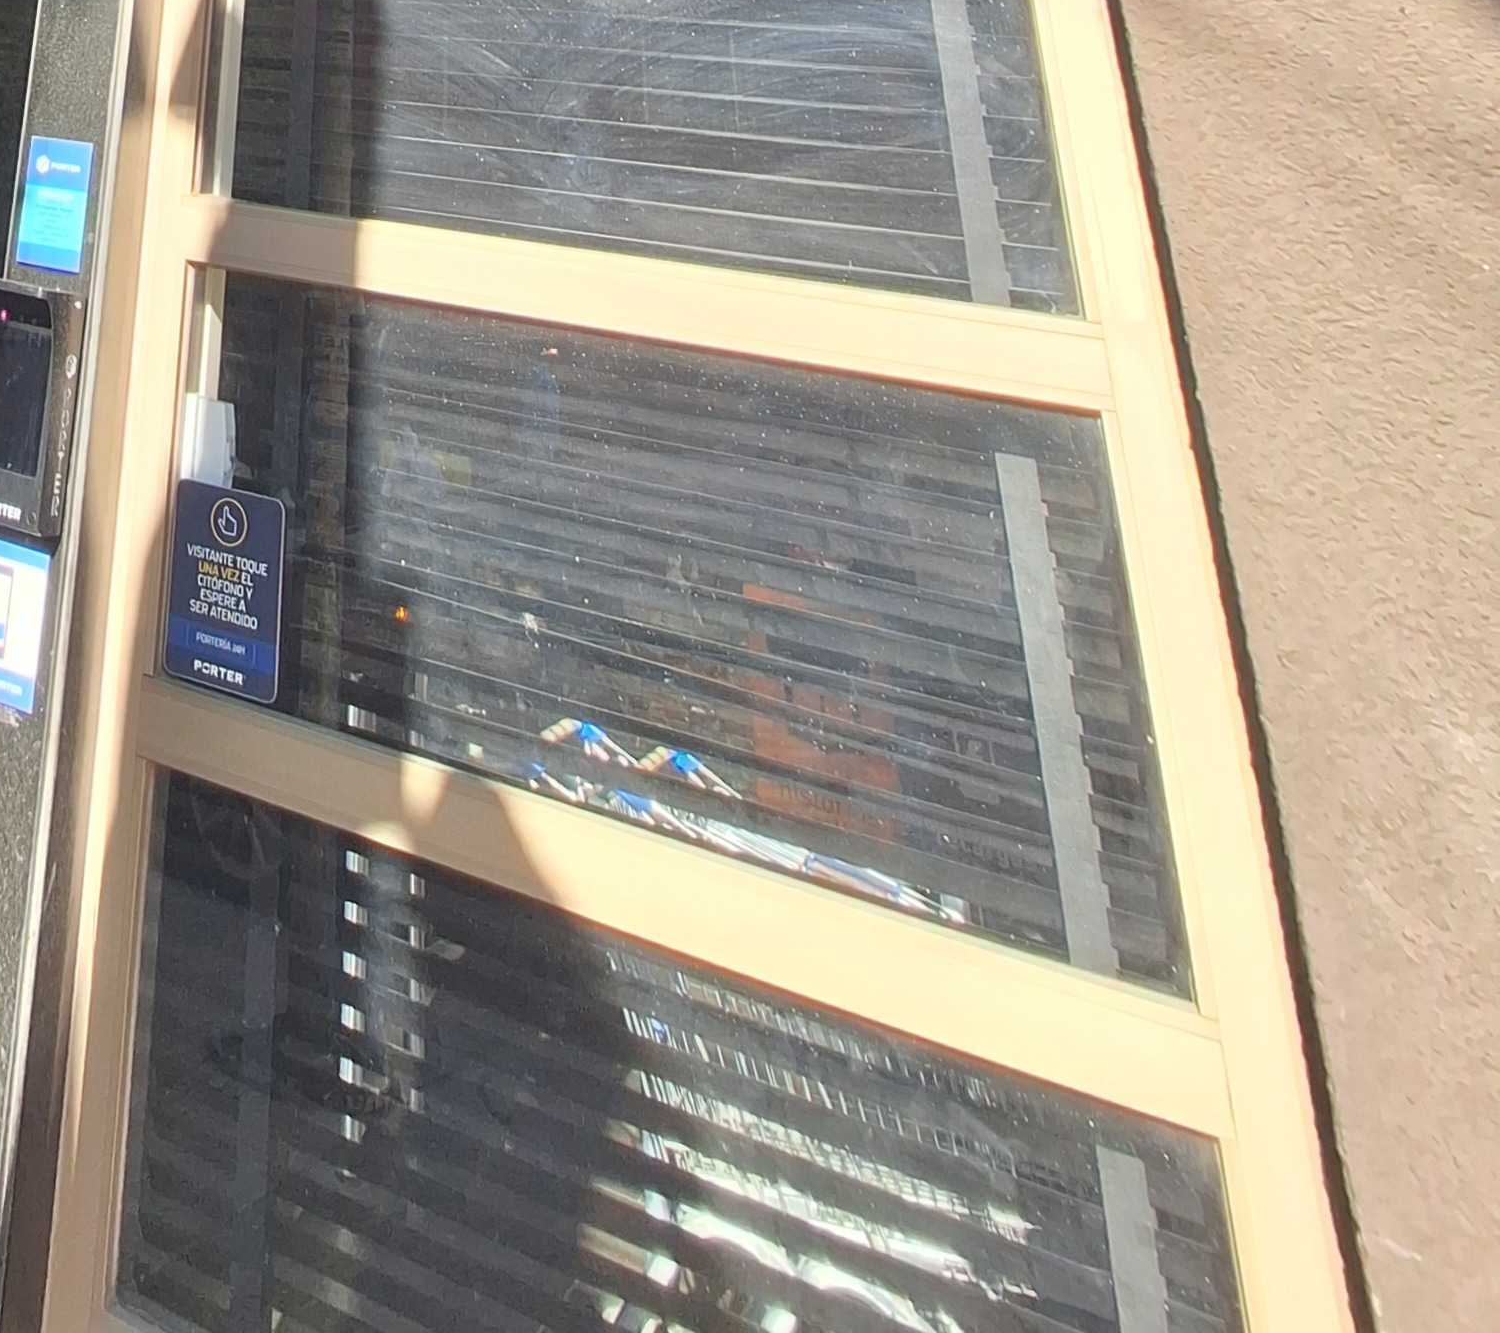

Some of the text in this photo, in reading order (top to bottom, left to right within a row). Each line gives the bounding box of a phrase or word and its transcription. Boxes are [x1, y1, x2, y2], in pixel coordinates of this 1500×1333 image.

[187, 543, 268, 577] VISITANTE TOQUE
[199, 560, 254, 586] UNA VEZ EL
[200, 588, 247, 613] ESPERE A
[246, 586, 253, 601] Y
[189, 599, 258, 630] SER ATENDIDO
[193, 658, 243, 686] PORTER
